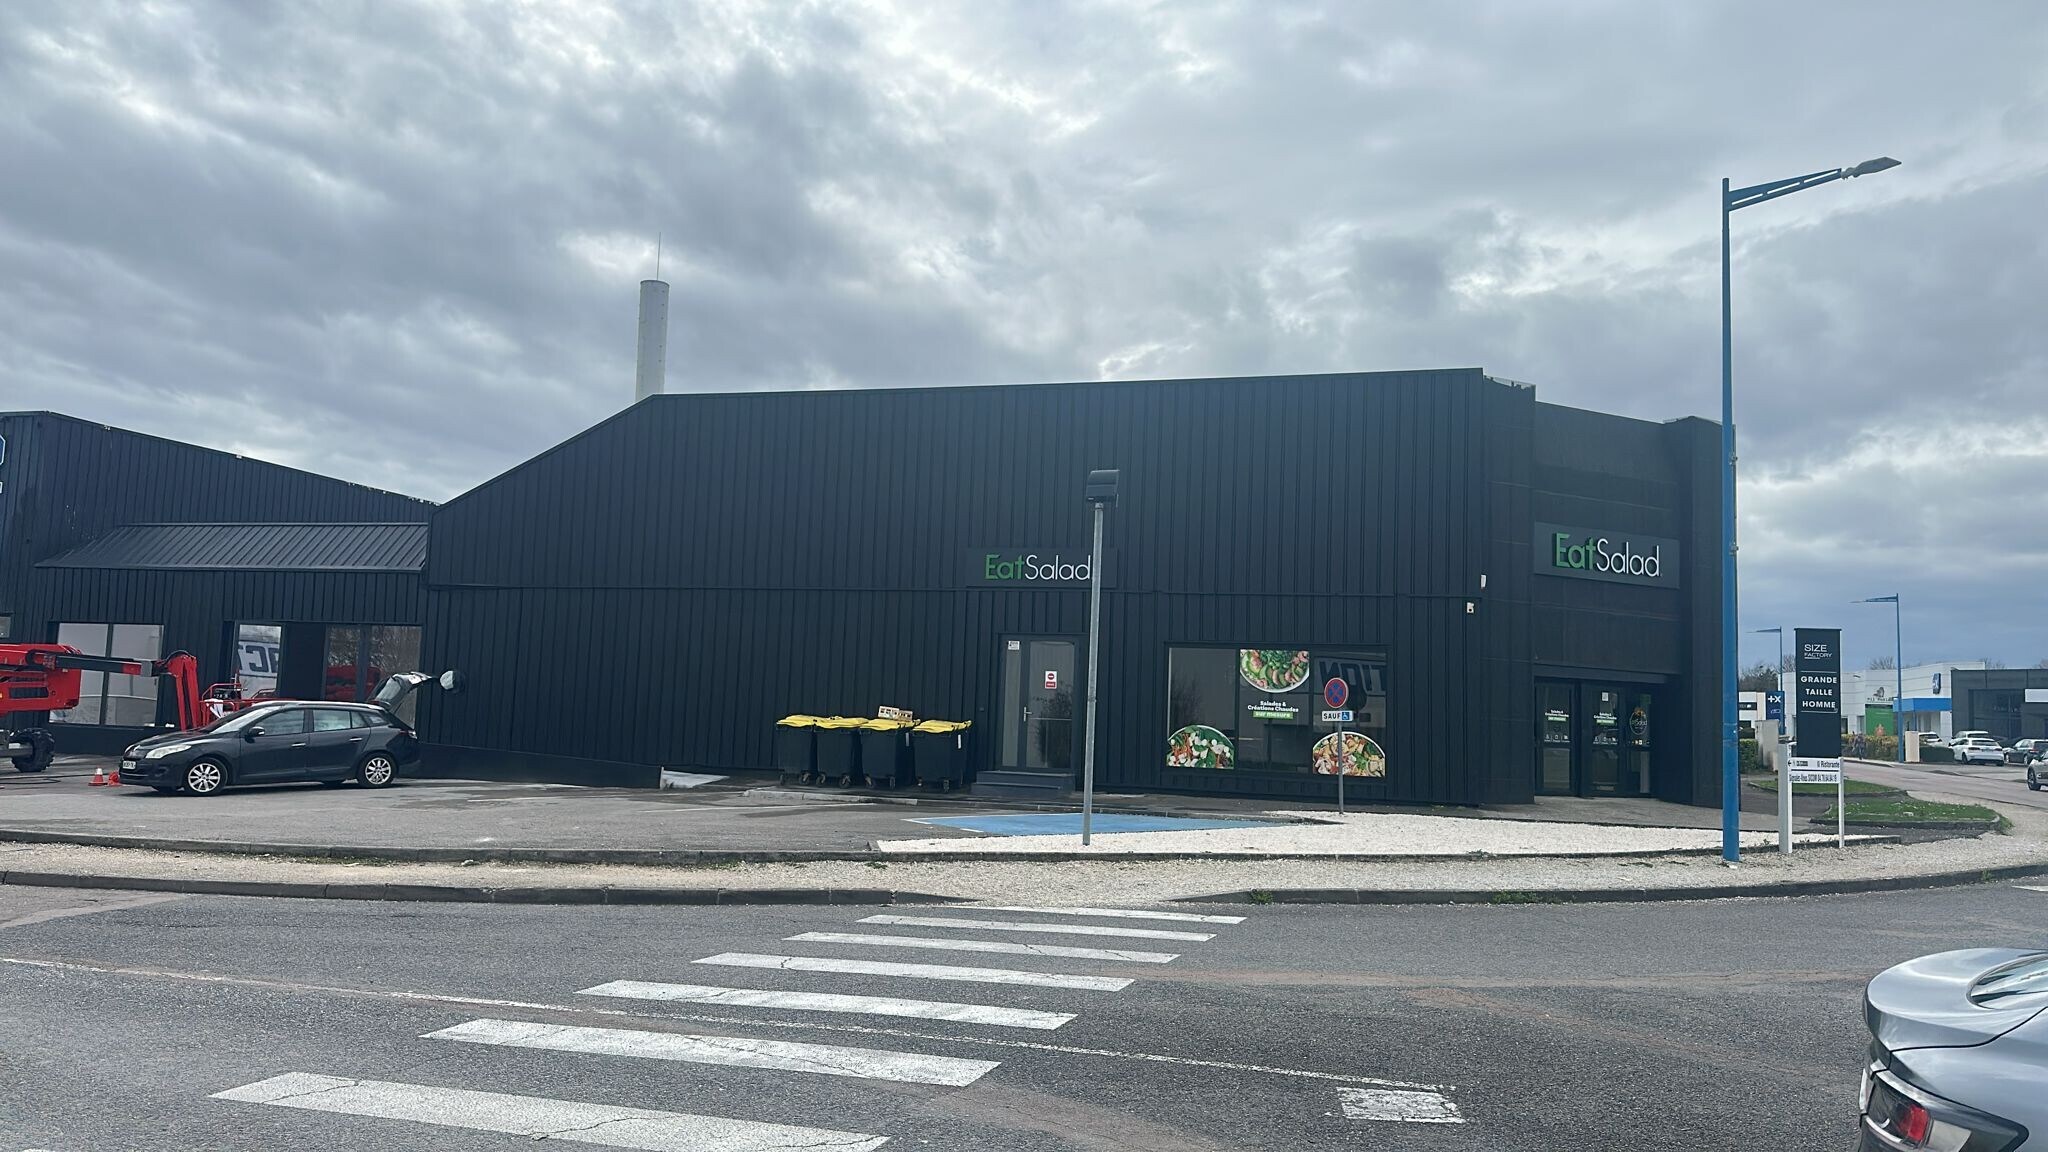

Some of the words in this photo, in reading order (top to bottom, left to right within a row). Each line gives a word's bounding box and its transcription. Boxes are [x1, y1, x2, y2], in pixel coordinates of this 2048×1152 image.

[1804, 643, 1828, 652] SIZE
[1800, 675, 1838, 684] GRANDE
[1805, 688, 1833, 696] TAILLE
[1802, 700, 1836, 709] HOMME
